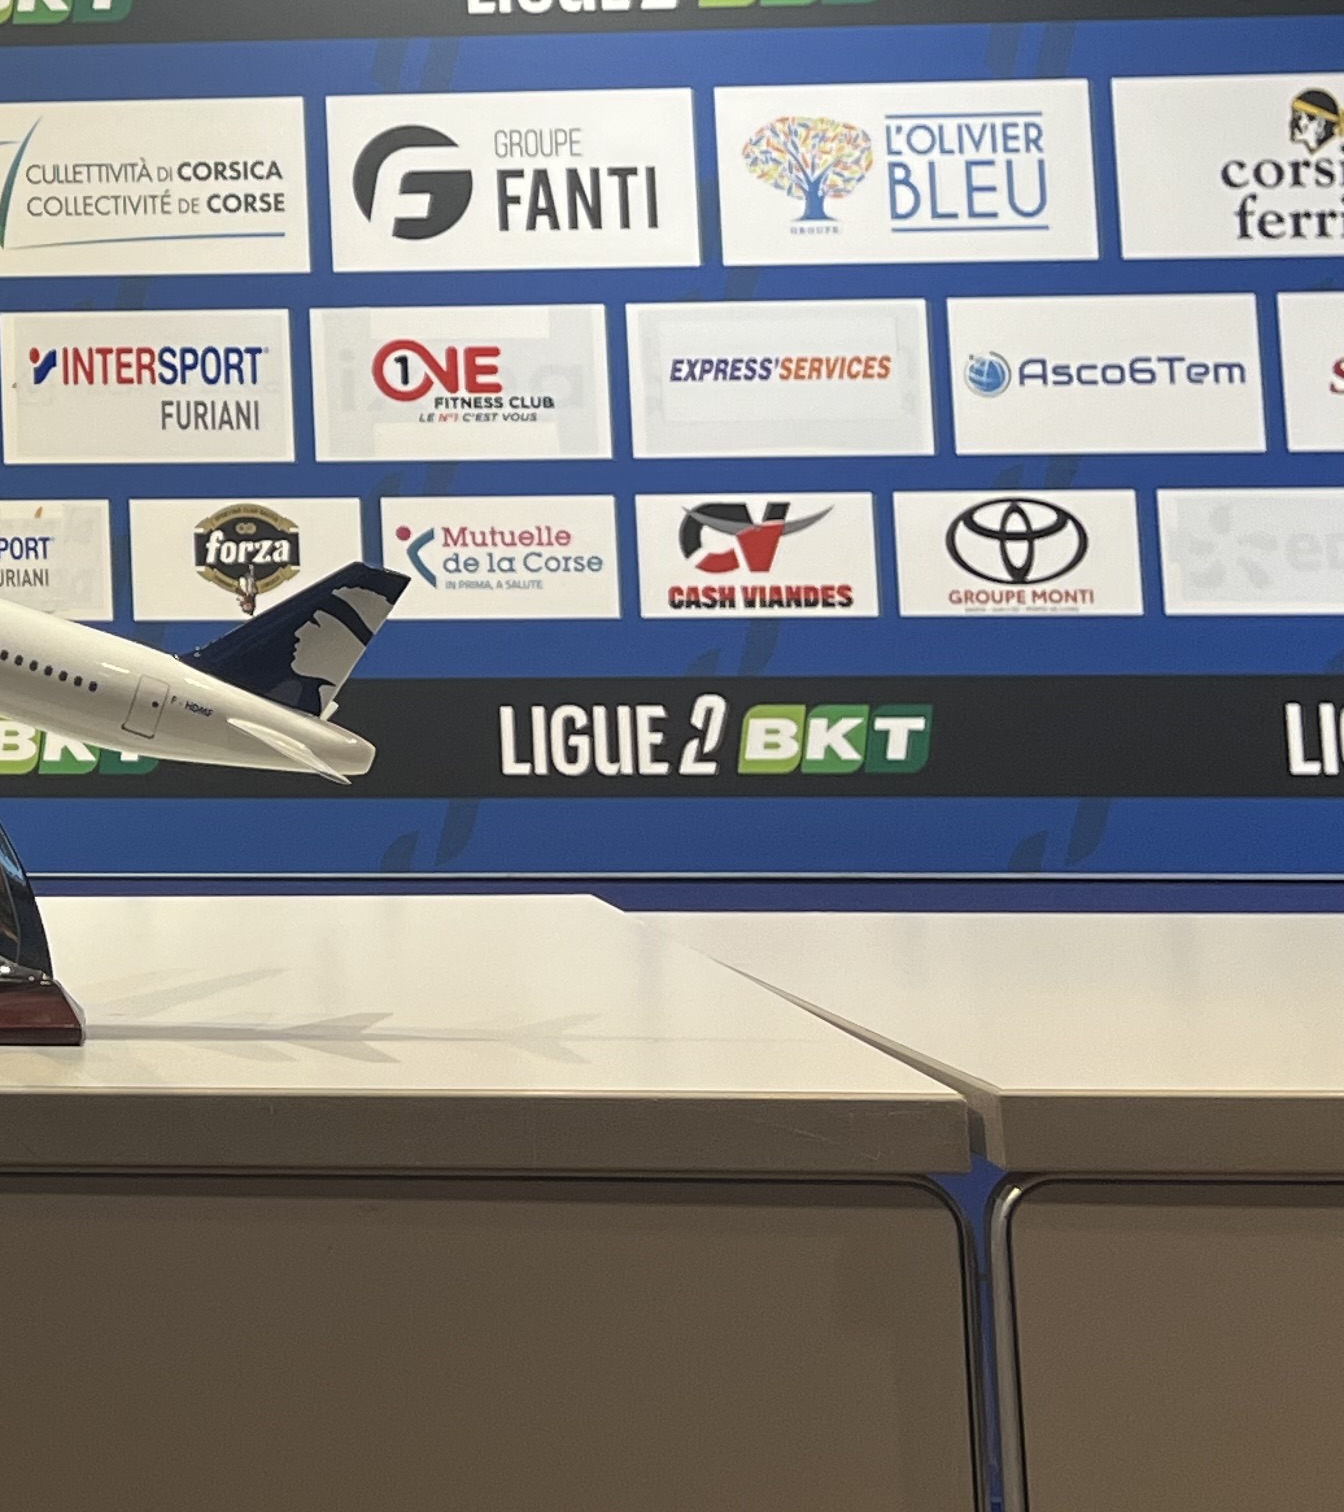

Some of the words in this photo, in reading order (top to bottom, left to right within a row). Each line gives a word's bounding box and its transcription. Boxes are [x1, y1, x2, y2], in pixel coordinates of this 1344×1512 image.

[494, 128, 581, 158] GROUPE
[886, 122, 1043, 155] L'OLIVIER
[26, 158, 152, 184] CULLETTIVITÀ
[157, 166, 173, 182] DI
[178, 161, 282, 181] CORSICA
[27, 189, 171, 216] COLLECTIVITÉ
[178, 198, 199, 214] DE
[207, 193, 284, 213] CORSE
[497, 167, 658, 231] FANTI
[888, 159, 1047, 220] BLEU
[63, 347, 262, 385] INTERSPORT
[1019, 357, 1245, 385] Asco6Tem
[161, 401, 259, 430] FURIANI
[435, 397, 503, 409] FITNESS
[509, 397, 554, 409] CLUB
[442, 526, 571, 547] Mutuelle
[205, 534, 291, 568] forza
[443, 552, 479, 575] de
[487, 551, 516, 574] la
[523, 552, 603, 572] Corse
[669, 587, 735, 609] CASH
[742, 585, 853, 608] VIANDES
[948, 589, 1024, 605] GROUPE
[1030, 588, 1095, 604] MONTI
[500, 705, 669, 775] LIGUE
[744, 716, 926, 760] BKT
